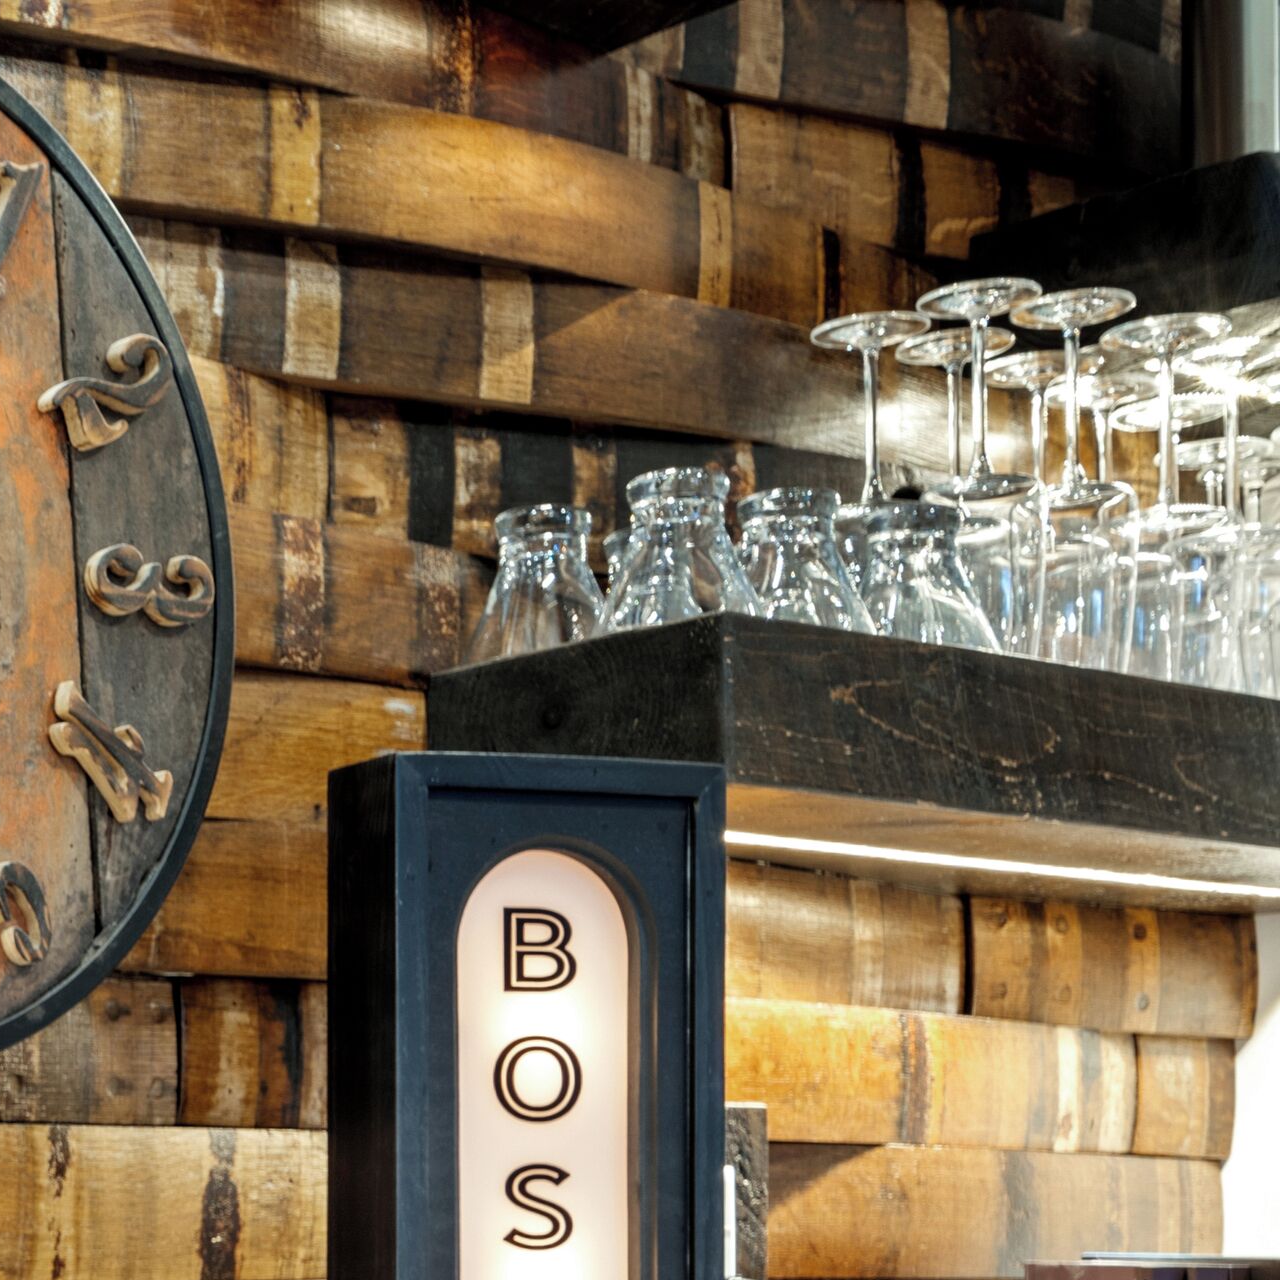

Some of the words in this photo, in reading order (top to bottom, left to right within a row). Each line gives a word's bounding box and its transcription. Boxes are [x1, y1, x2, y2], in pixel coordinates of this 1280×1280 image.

[38, 332, 174, 453] 2
[85, 542, 215, 627] 3
[48, 680, 174, 824] 4
